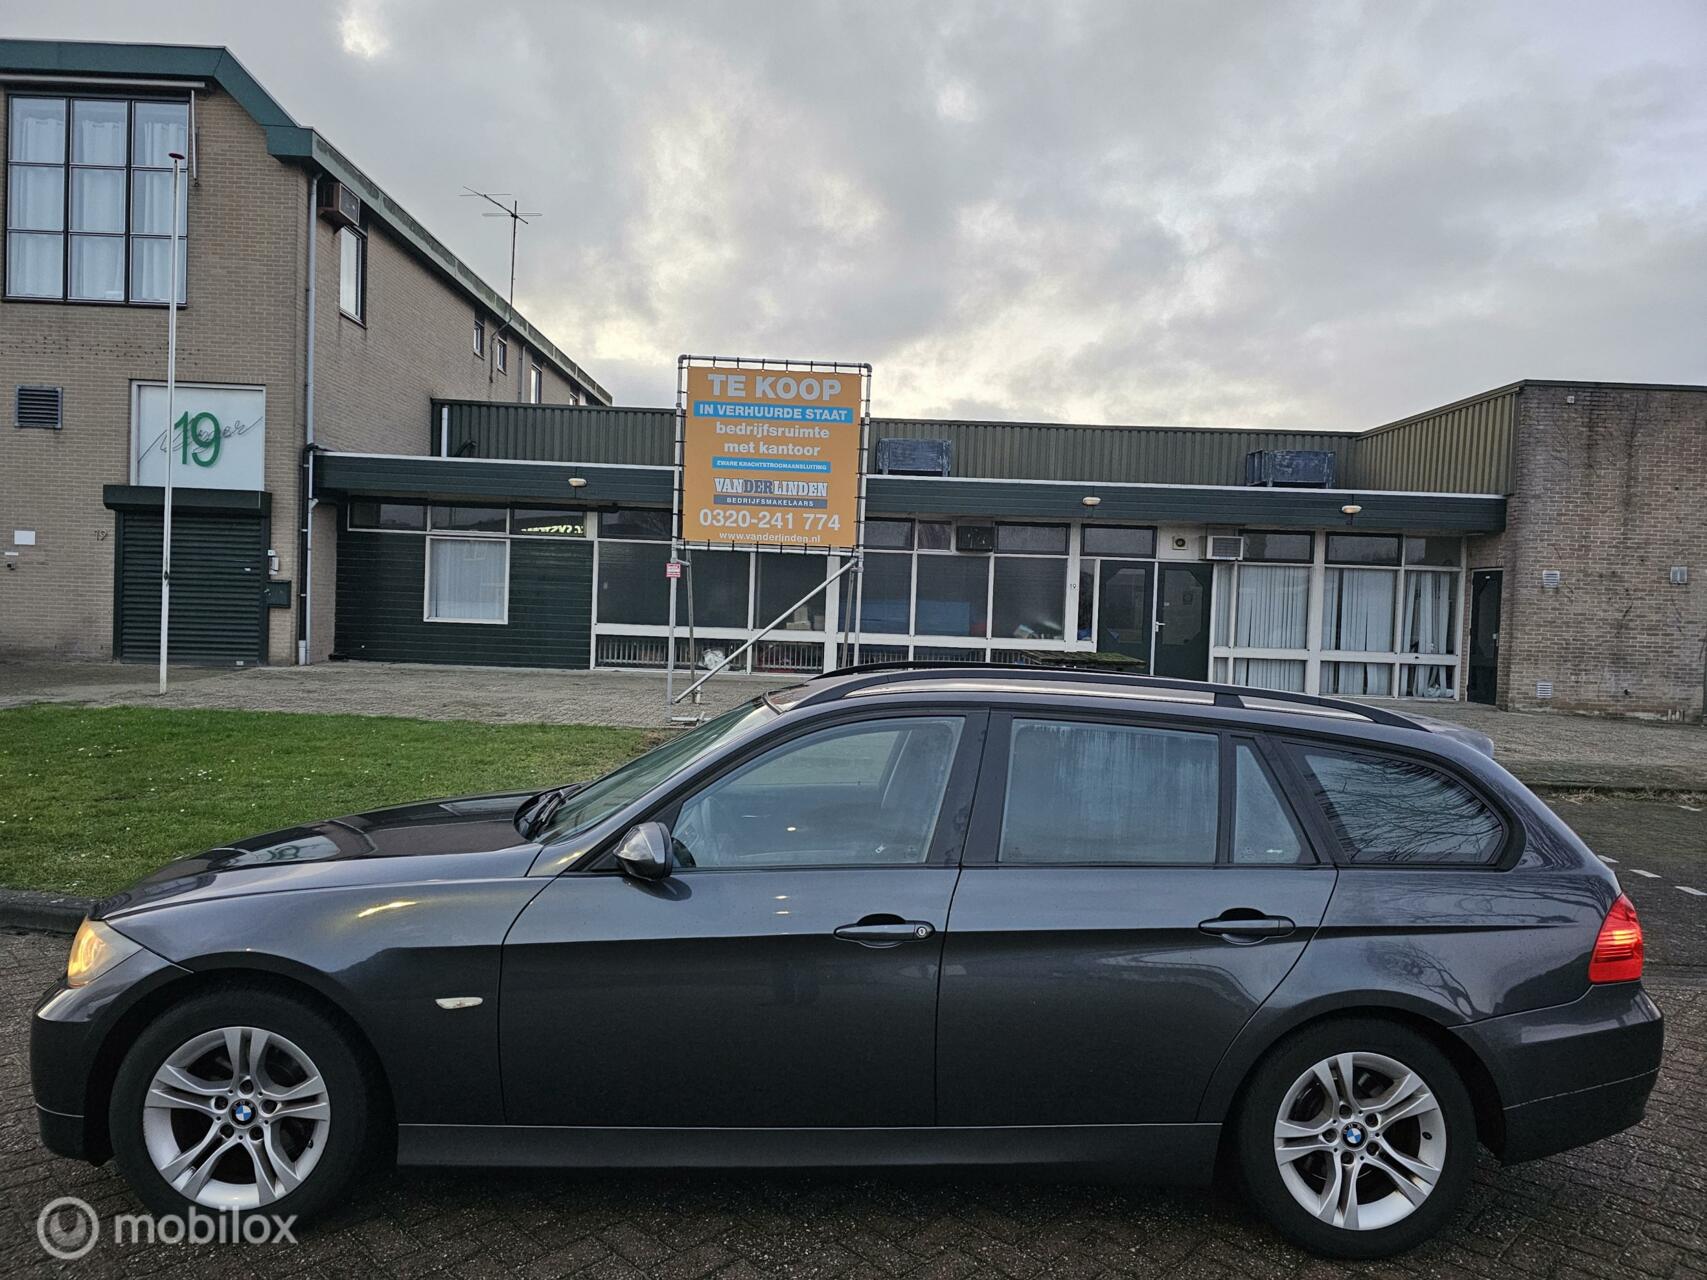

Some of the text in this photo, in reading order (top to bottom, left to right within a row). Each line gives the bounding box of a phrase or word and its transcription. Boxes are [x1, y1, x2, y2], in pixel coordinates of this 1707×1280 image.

[707, 374, 842, 401] TE KOOP
[699, 403, 847, 421] IN VERHUURDE STAAT
[716, 422, 830, 438] bedrijfsruimte
[174, 411, 221, 467] 19
[724, 441, 821, 456] met kantoor
[726, 497, 814, 507] BEDRIJFSMAKELAARS
[699, 509, 841, 531] 0320-241 774
[719, 531, 821, 544] www.vanderlinden.nl
